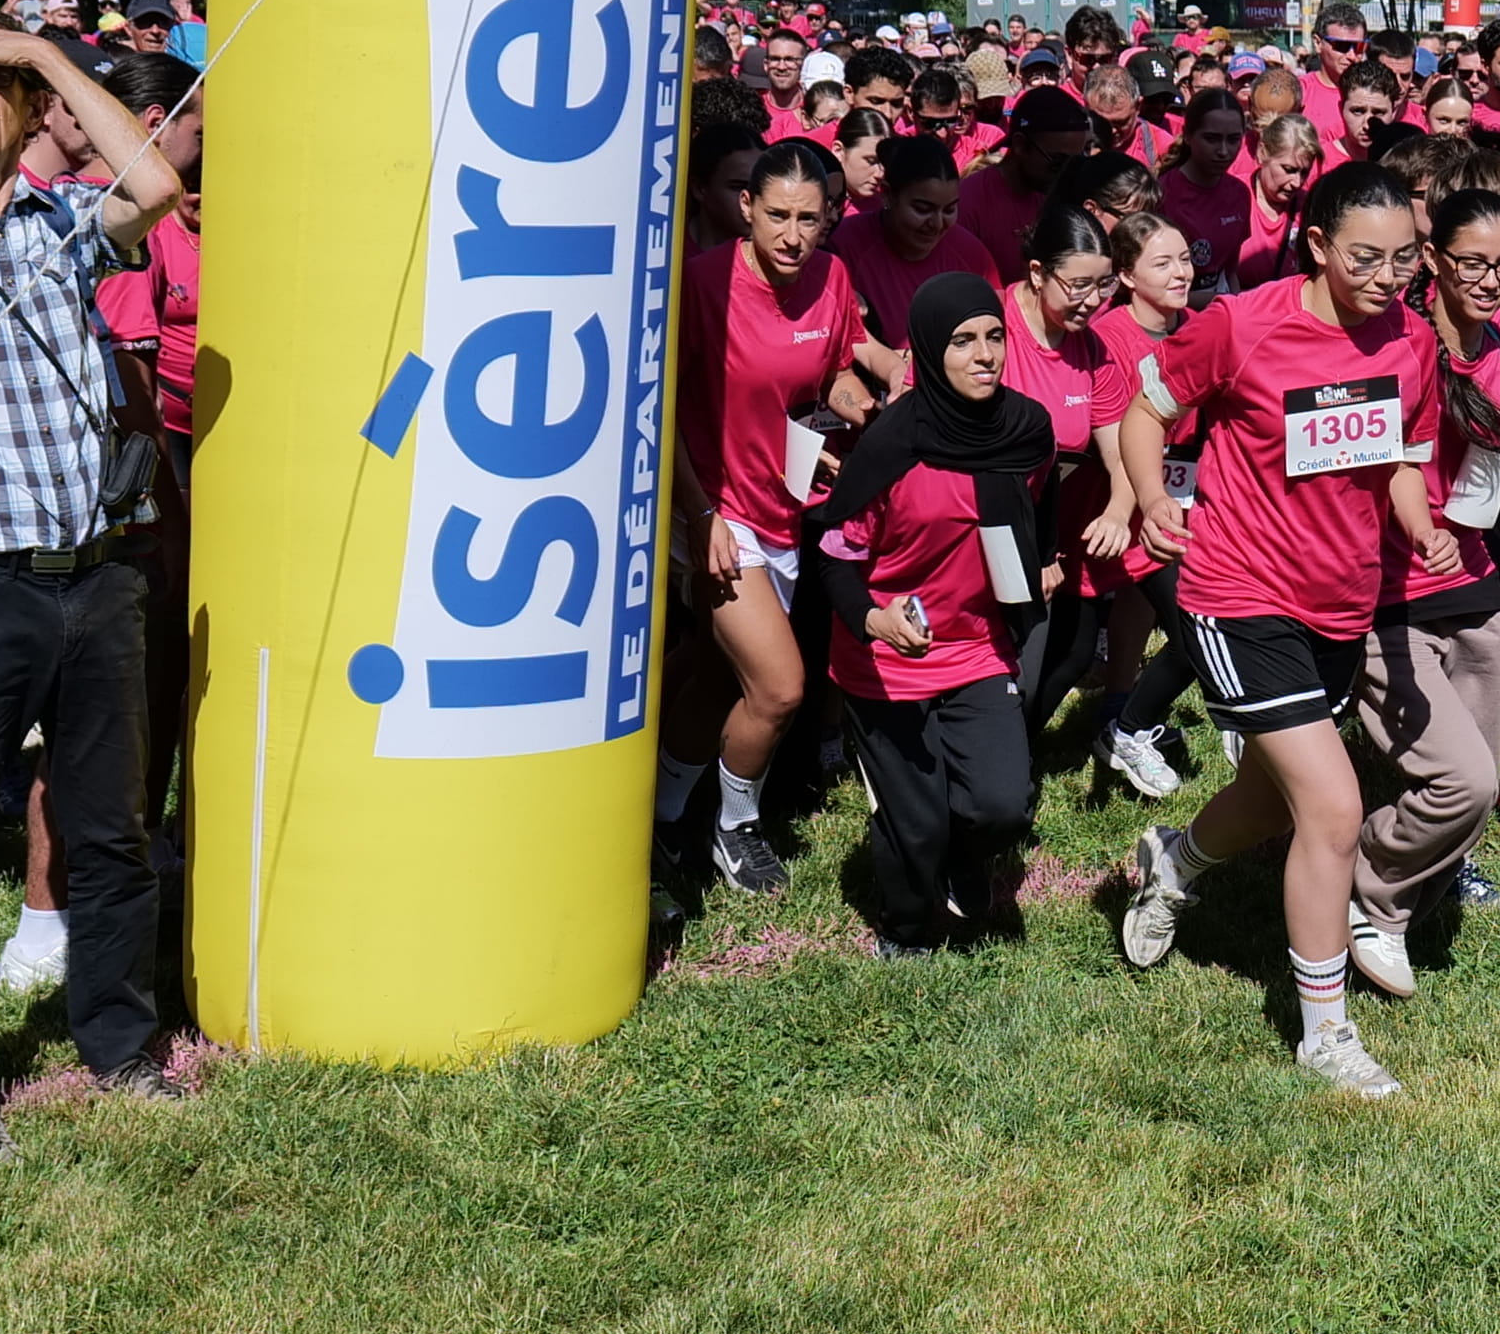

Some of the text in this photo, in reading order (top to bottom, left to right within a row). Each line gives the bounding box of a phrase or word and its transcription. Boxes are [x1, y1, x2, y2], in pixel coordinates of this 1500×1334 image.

[1302, 408, 1387, 448] 1305
[1297, 448, 1392, 471] Crédit Mutuel
[617, 625, 647, 725] LE
